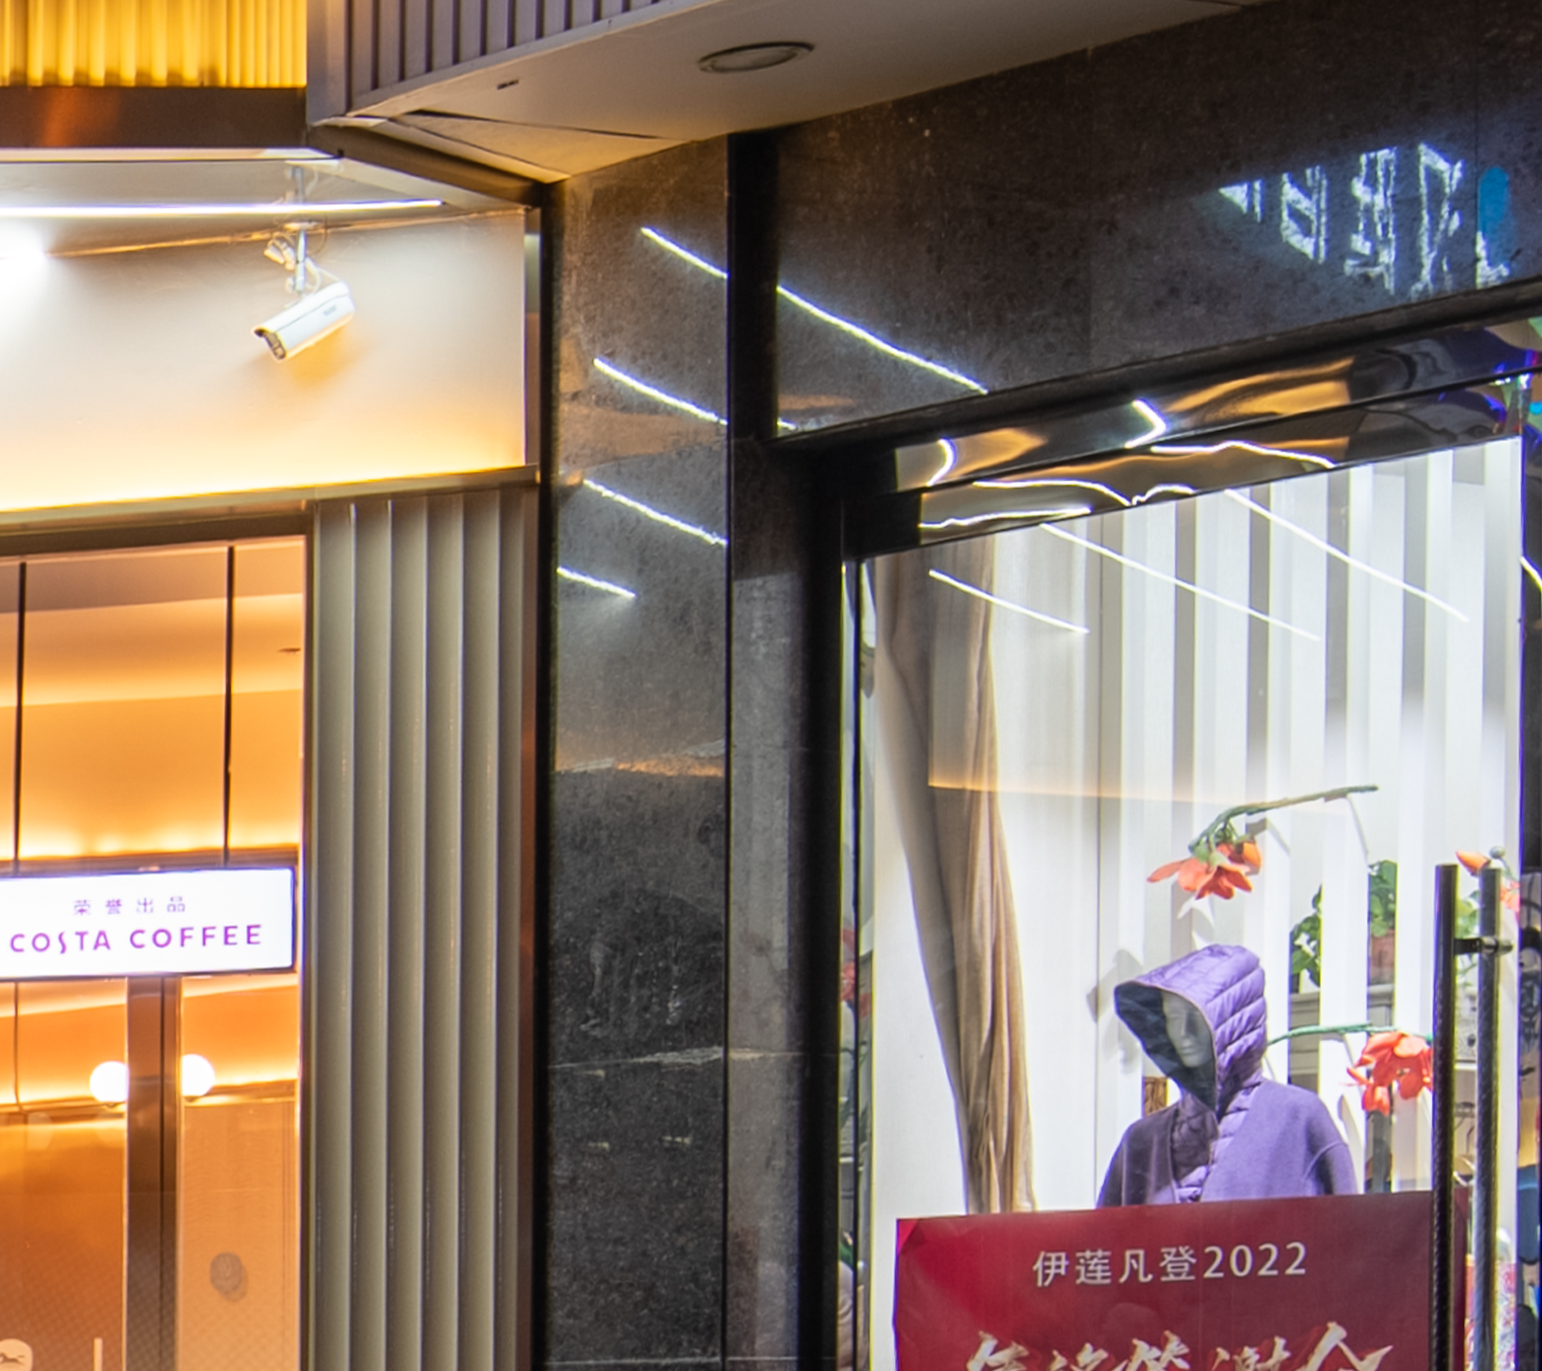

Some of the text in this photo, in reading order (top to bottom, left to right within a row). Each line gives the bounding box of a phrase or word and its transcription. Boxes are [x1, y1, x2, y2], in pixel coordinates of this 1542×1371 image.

[10, 924, 263, 954] COSTA COFFEE
[1031, 1241, 1308, 1288] 伊莲凡登2022
